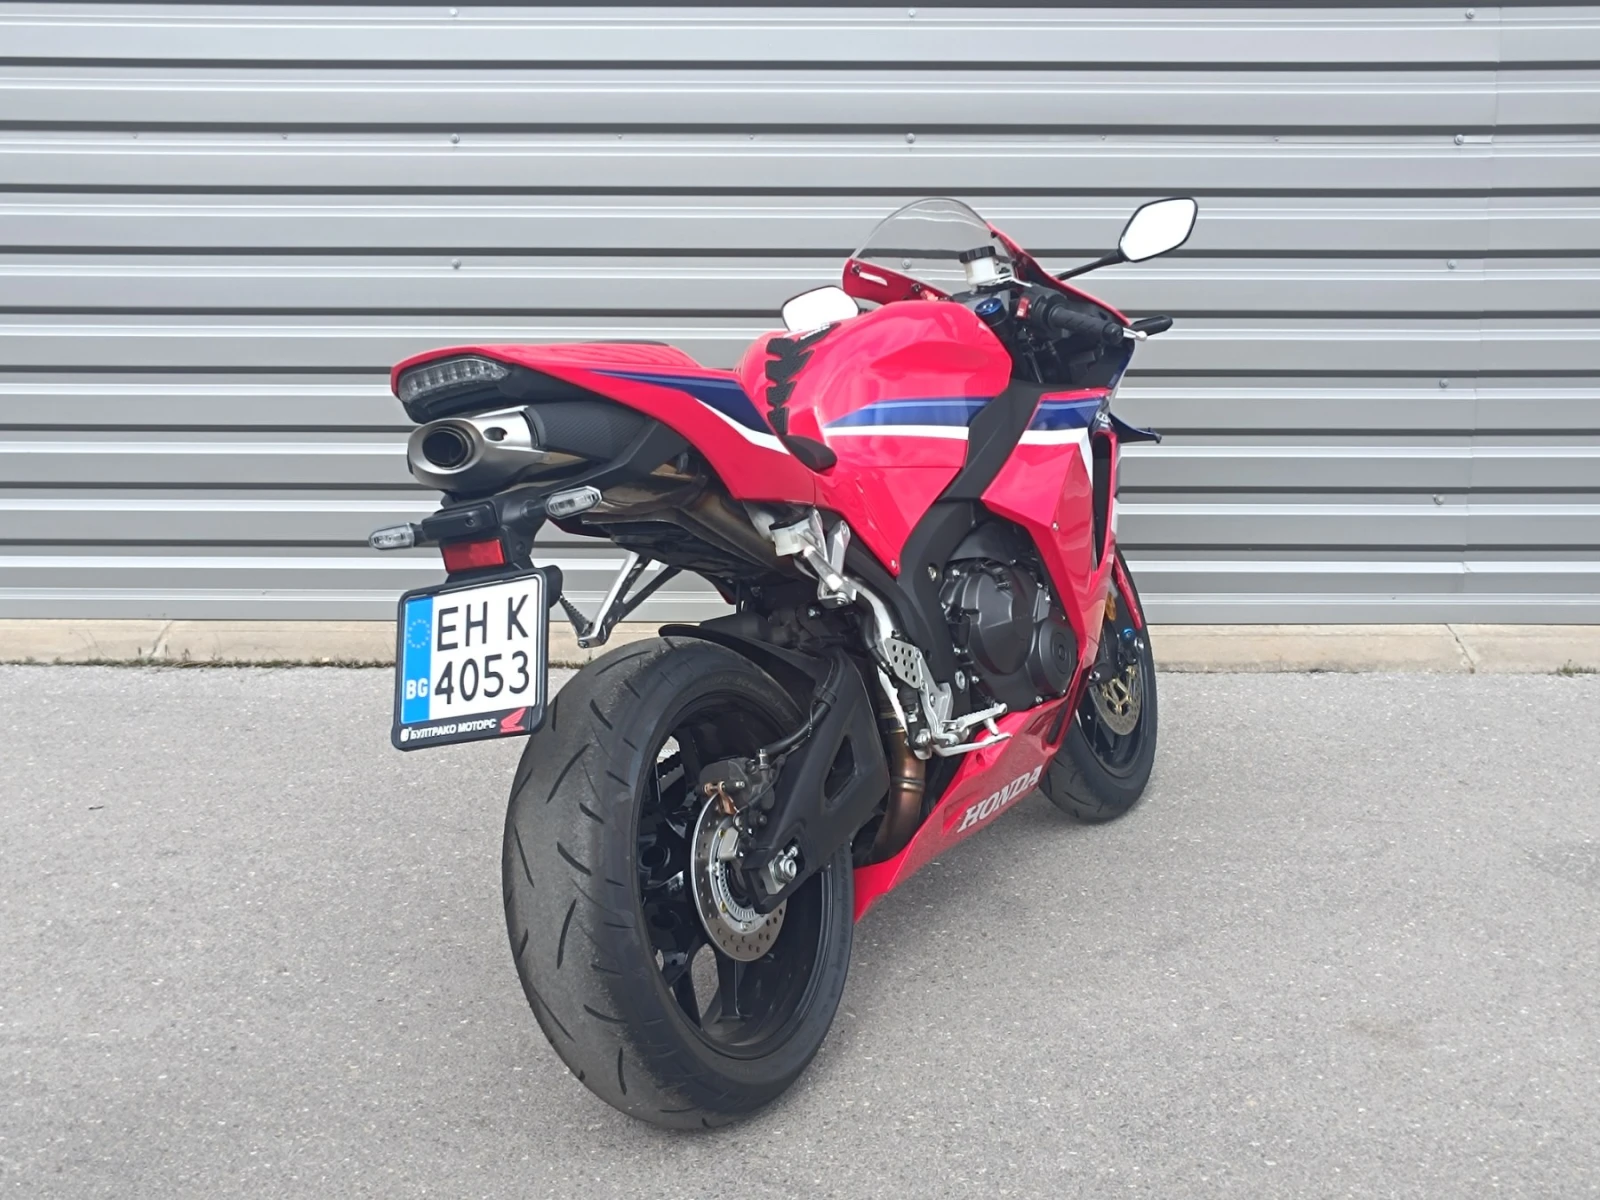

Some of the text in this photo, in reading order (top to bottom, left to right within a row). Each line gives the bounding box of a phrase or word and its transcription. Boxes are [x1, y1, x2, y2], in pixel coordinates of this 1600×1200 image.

[437, 594, 529, 652] EH K
[406, 678, 428, 699] BG
[434, 650, 530, 705] 4053
[410, 718, 497, 740] БУЛТРАКО МОТОРС
[957, 765, 1043, 833] HONDA
